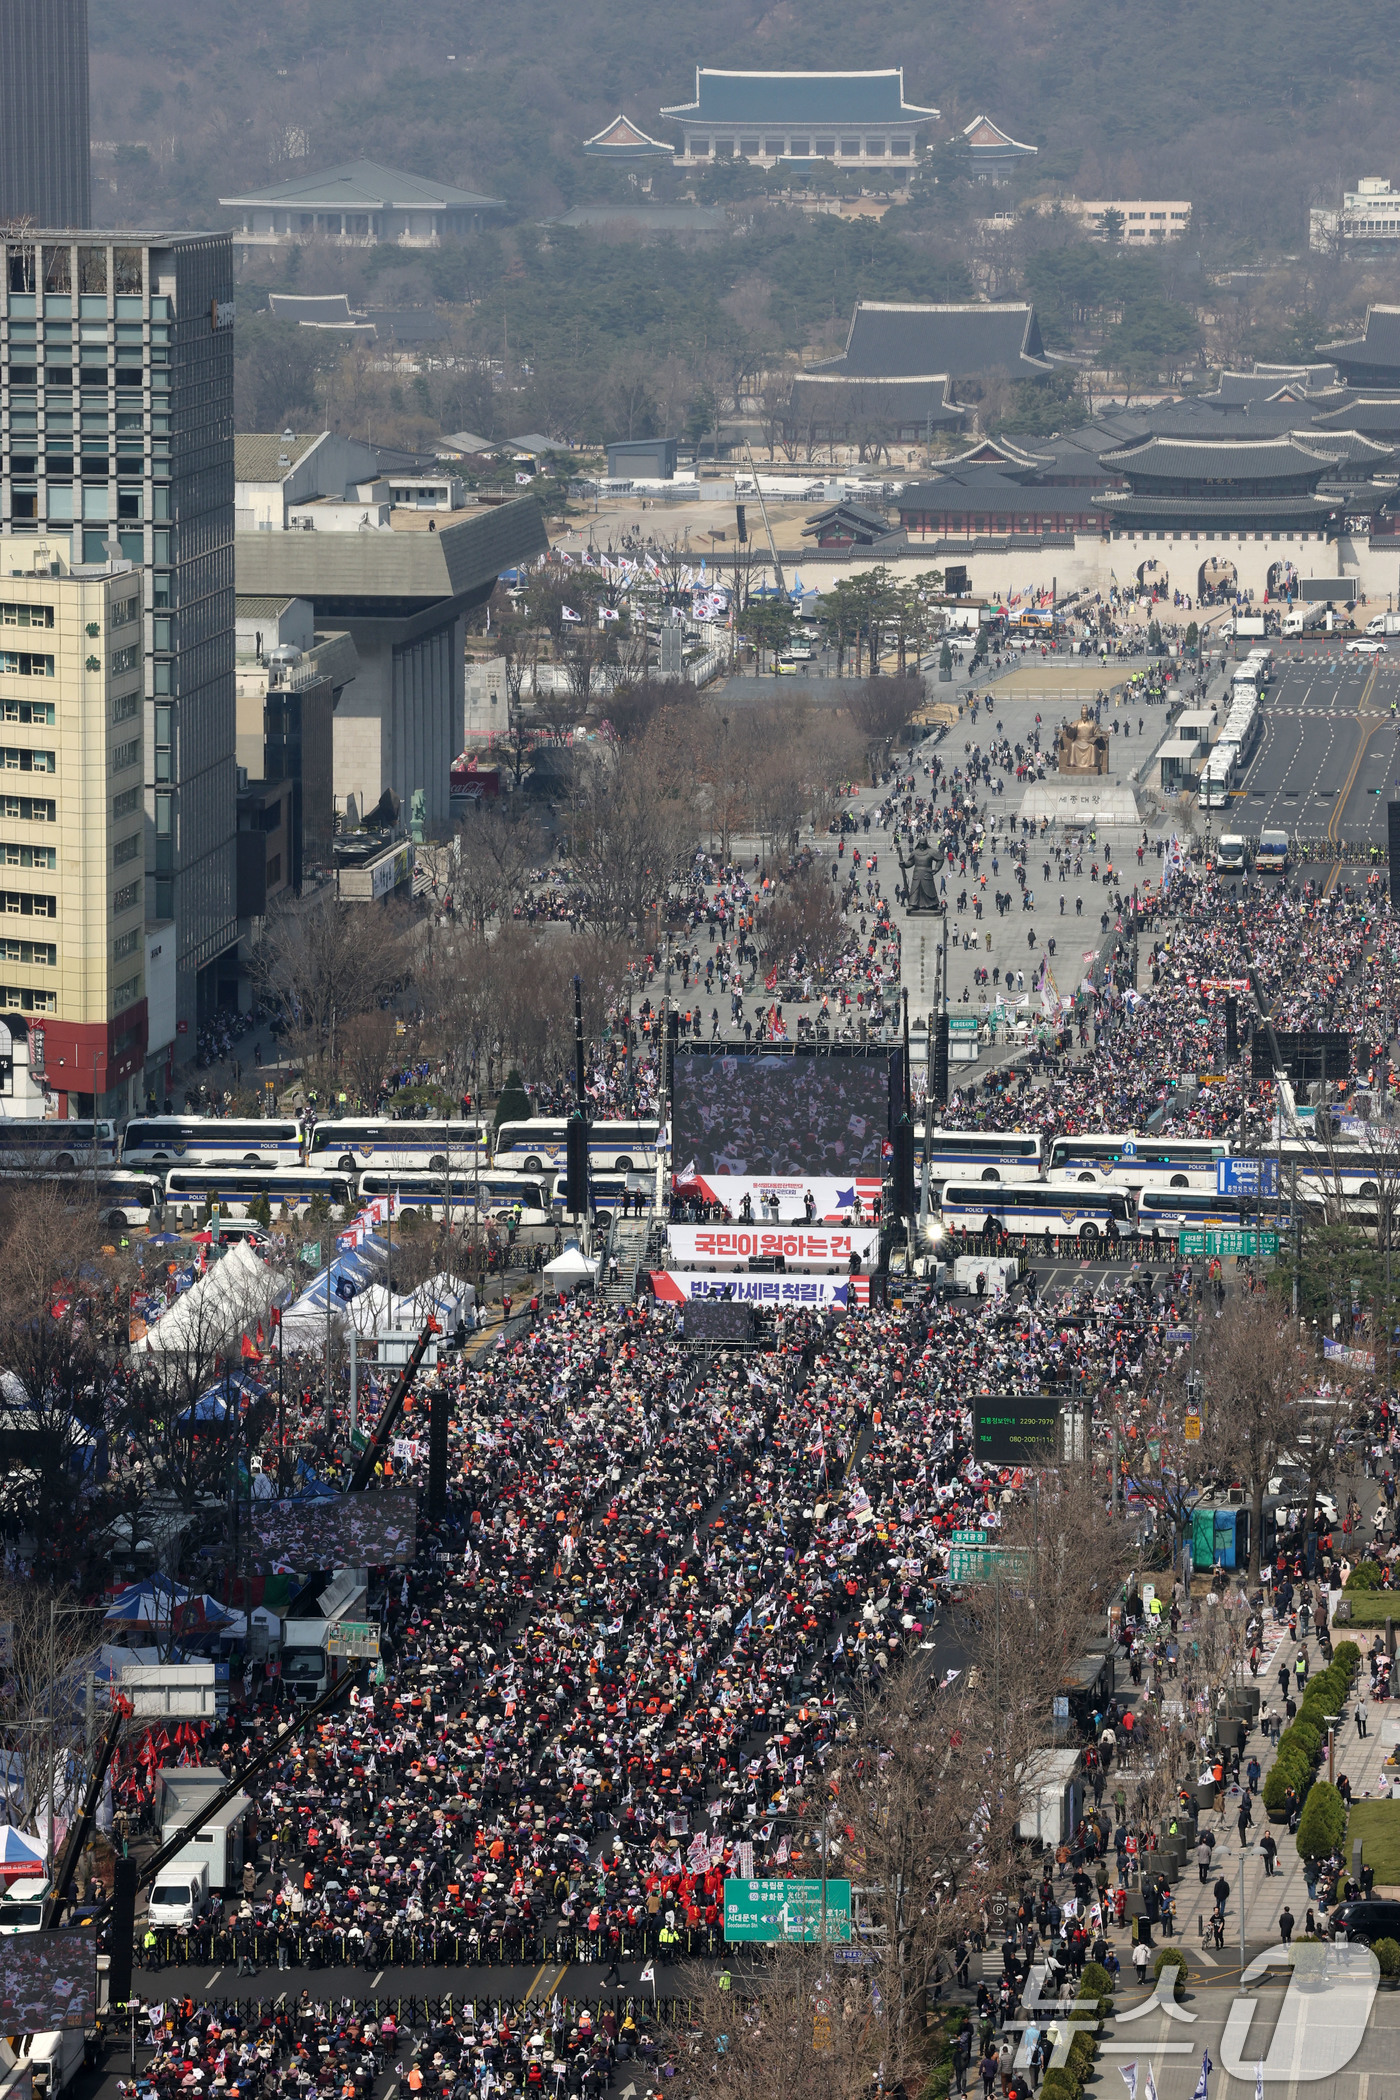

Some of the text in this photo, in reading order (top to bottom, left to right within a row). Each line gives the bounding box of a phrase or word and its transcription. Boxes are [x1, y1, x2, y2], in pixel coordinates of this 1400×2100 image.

[1058, 795, 1101, 805] 세종대왕
[694, 1233, 852, 1257] 국민이 원하는 건
[781, 1283, 825, 1302] 척결!
[980, 1417, 1016, 1425] 교통정보안내
[955, 1533, 984, 1541] 청계광장
[760, 1881, 785, 1890] 독립문
[760, 1892, 785, 1902] 광화문
[727, 1913, 758, 1922] 서대문역
